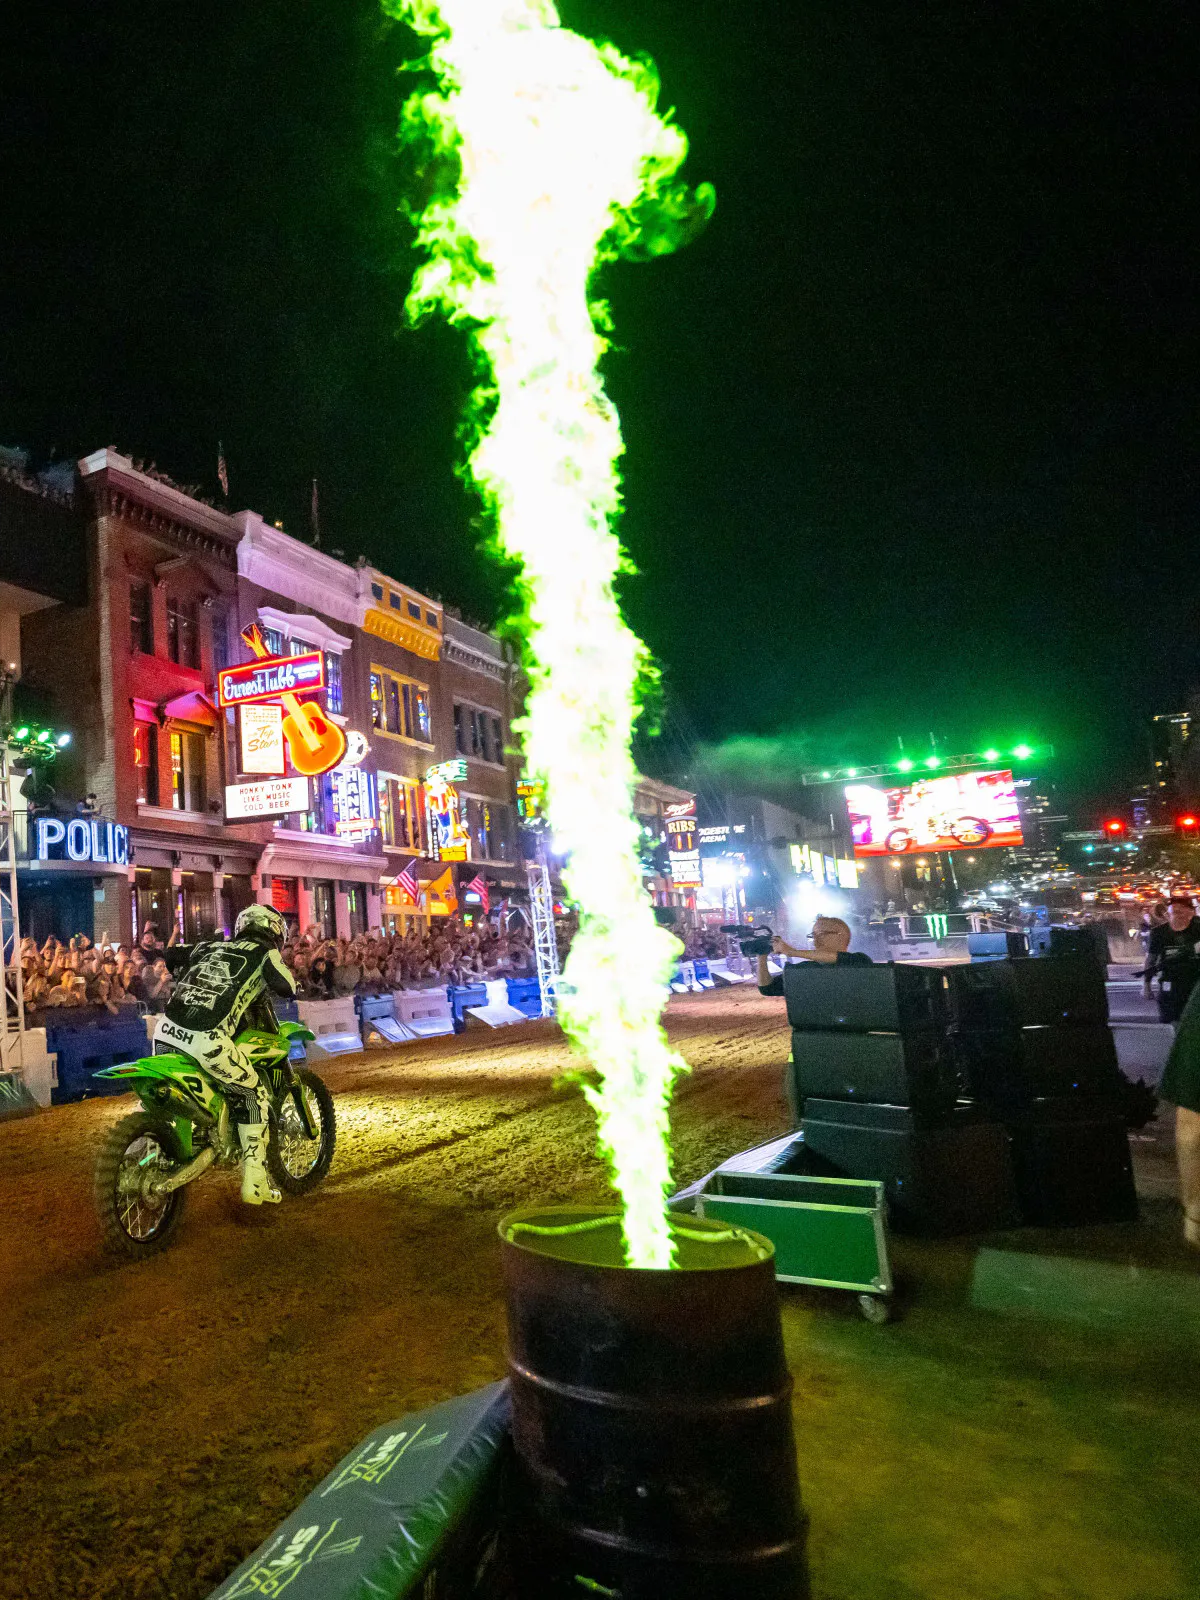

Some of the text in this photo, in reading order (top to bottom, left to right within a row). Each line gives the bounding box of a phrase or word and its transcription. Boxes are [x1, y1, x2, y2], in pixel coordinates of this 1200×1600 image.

[223, 673, 264, 701] Ernest
[252, 664, 296, 692] Tubb
[256, 725, 275, 739] Top
[247, 738, 279, 753] Stars
[239, 782, 293, 795] HONKY TONK
[243, 791, 291, 803] LIVE MUSIC
[243, 800, 290, 812] COLD BEER
[667, 820, 696, 834] RIBS
[37, 817, 129, 867] POLIC
[699, 834, 727, 843] ARENA
[161, 1022, 195, 1045] CASH
